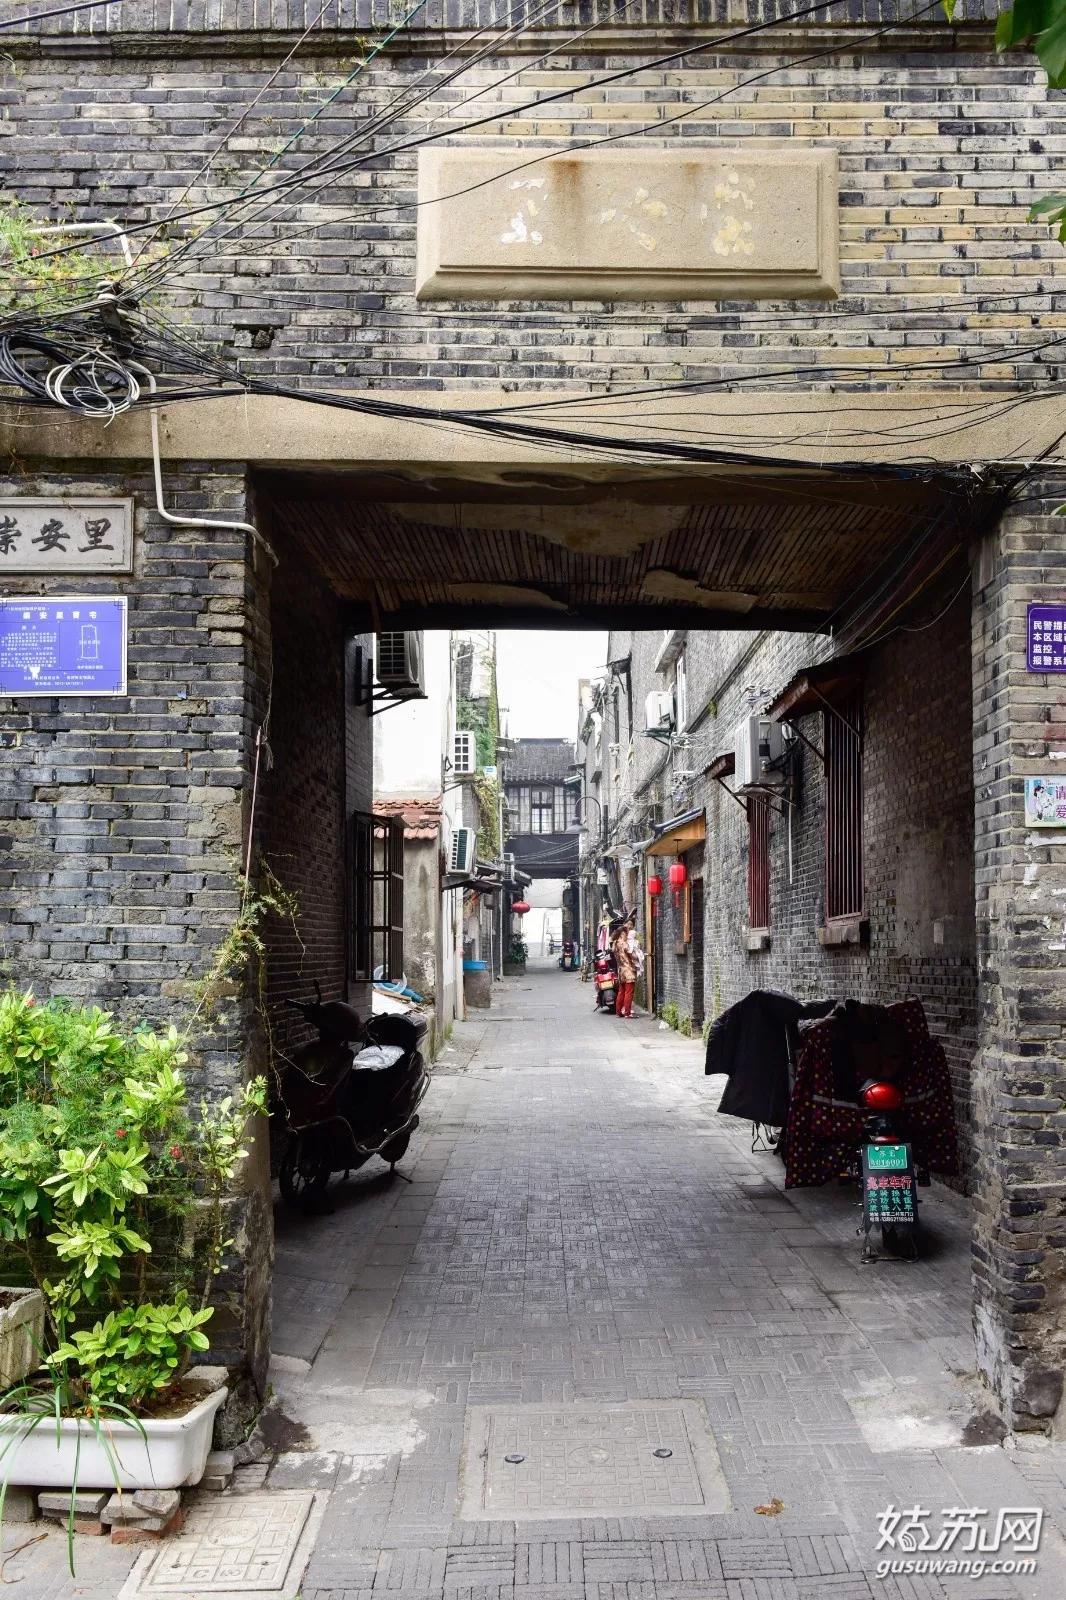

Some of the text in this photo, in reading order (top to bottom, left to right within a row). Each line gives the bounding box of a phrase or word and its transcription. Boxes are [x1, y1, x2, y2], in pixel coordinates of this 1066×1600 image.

[0, 515, 114, 555] 崇安里
[1033, 620, 1066, 631] 民警提
[1033, 632, 1066, 642] 本区域
[1033, 644, 1066, 654] 监控、
